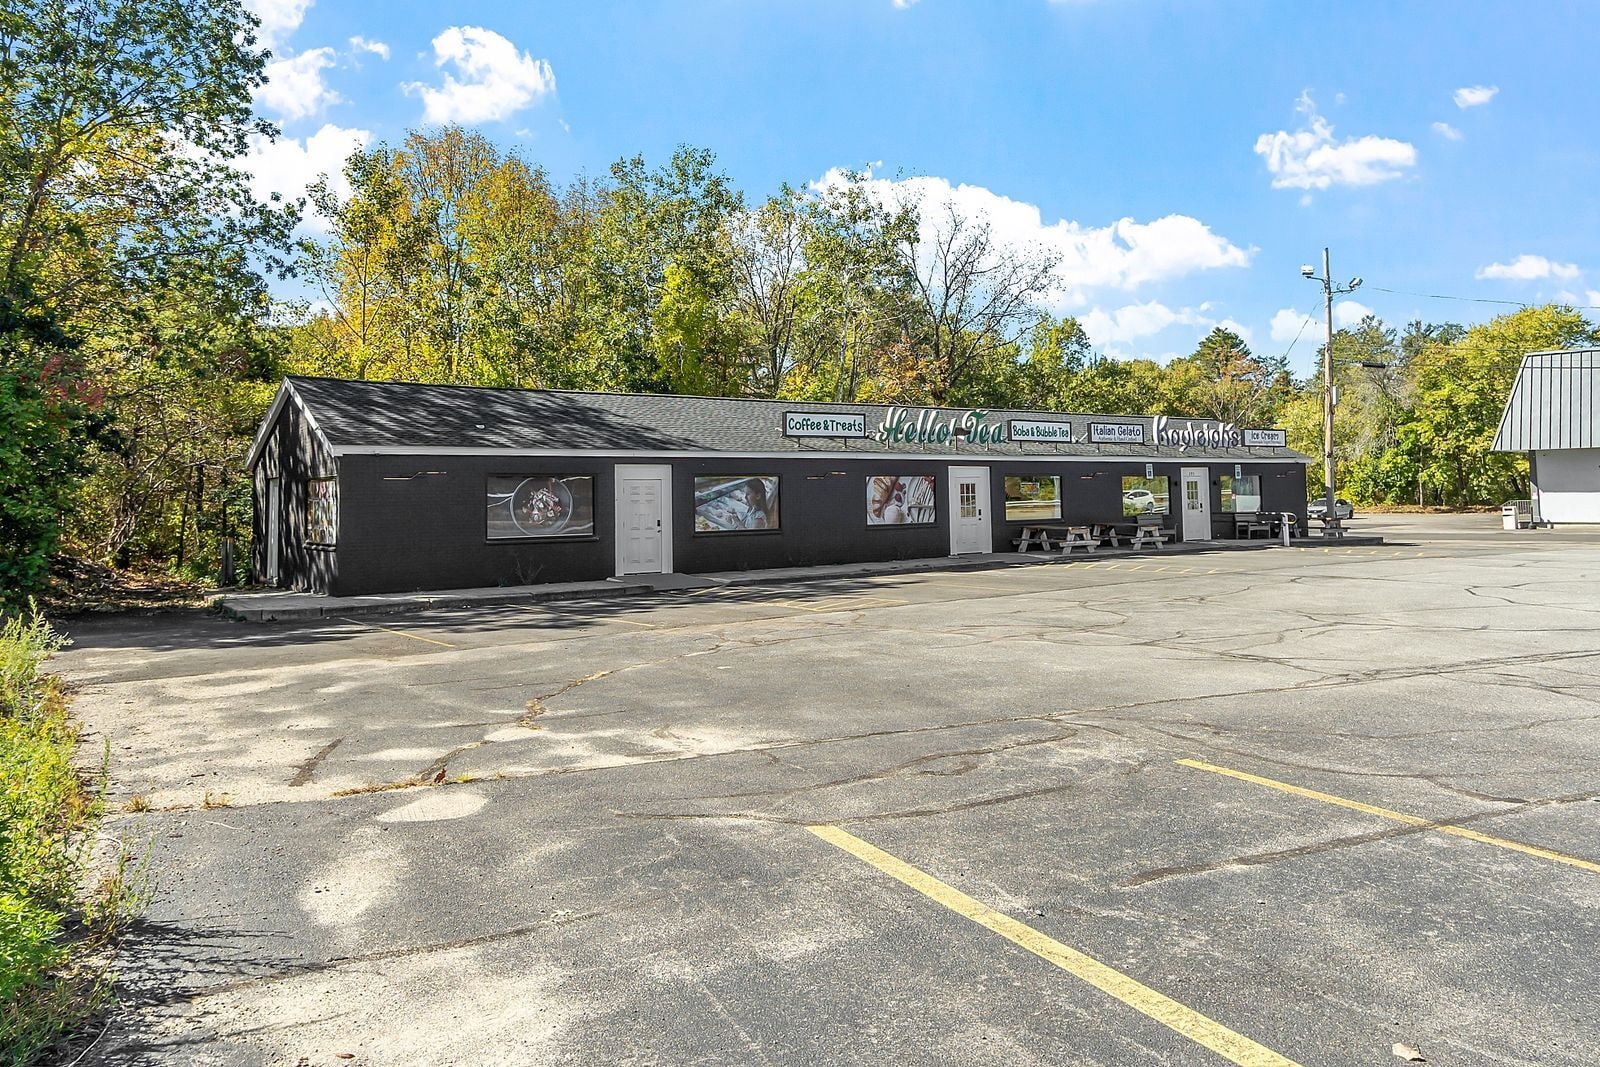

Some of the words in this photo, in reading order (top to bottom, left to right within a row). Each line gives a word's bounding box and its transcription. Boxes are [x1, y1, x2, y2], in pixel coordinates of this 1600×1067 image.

[788, 417, 821, 431] Coffee
[830, 419, 863, 432] Treats
[876, 406, 958, 446] Hello!
[961, 408, 1004, 444] Tea
[1012, 424, 1029, 437] Boba
[1035, 425, 1057, 438] Bubble
[1058, 426, 1069, 438] Tea
[1093, 424, 1116, 436] Italian
[1117, 425, 1141, 437] Gelato
[1152, 415, 1239, 453] Kayleigh's
[1251, 430, 1260, 441] Ice
[1260, 430, 1279, 441] Cream
